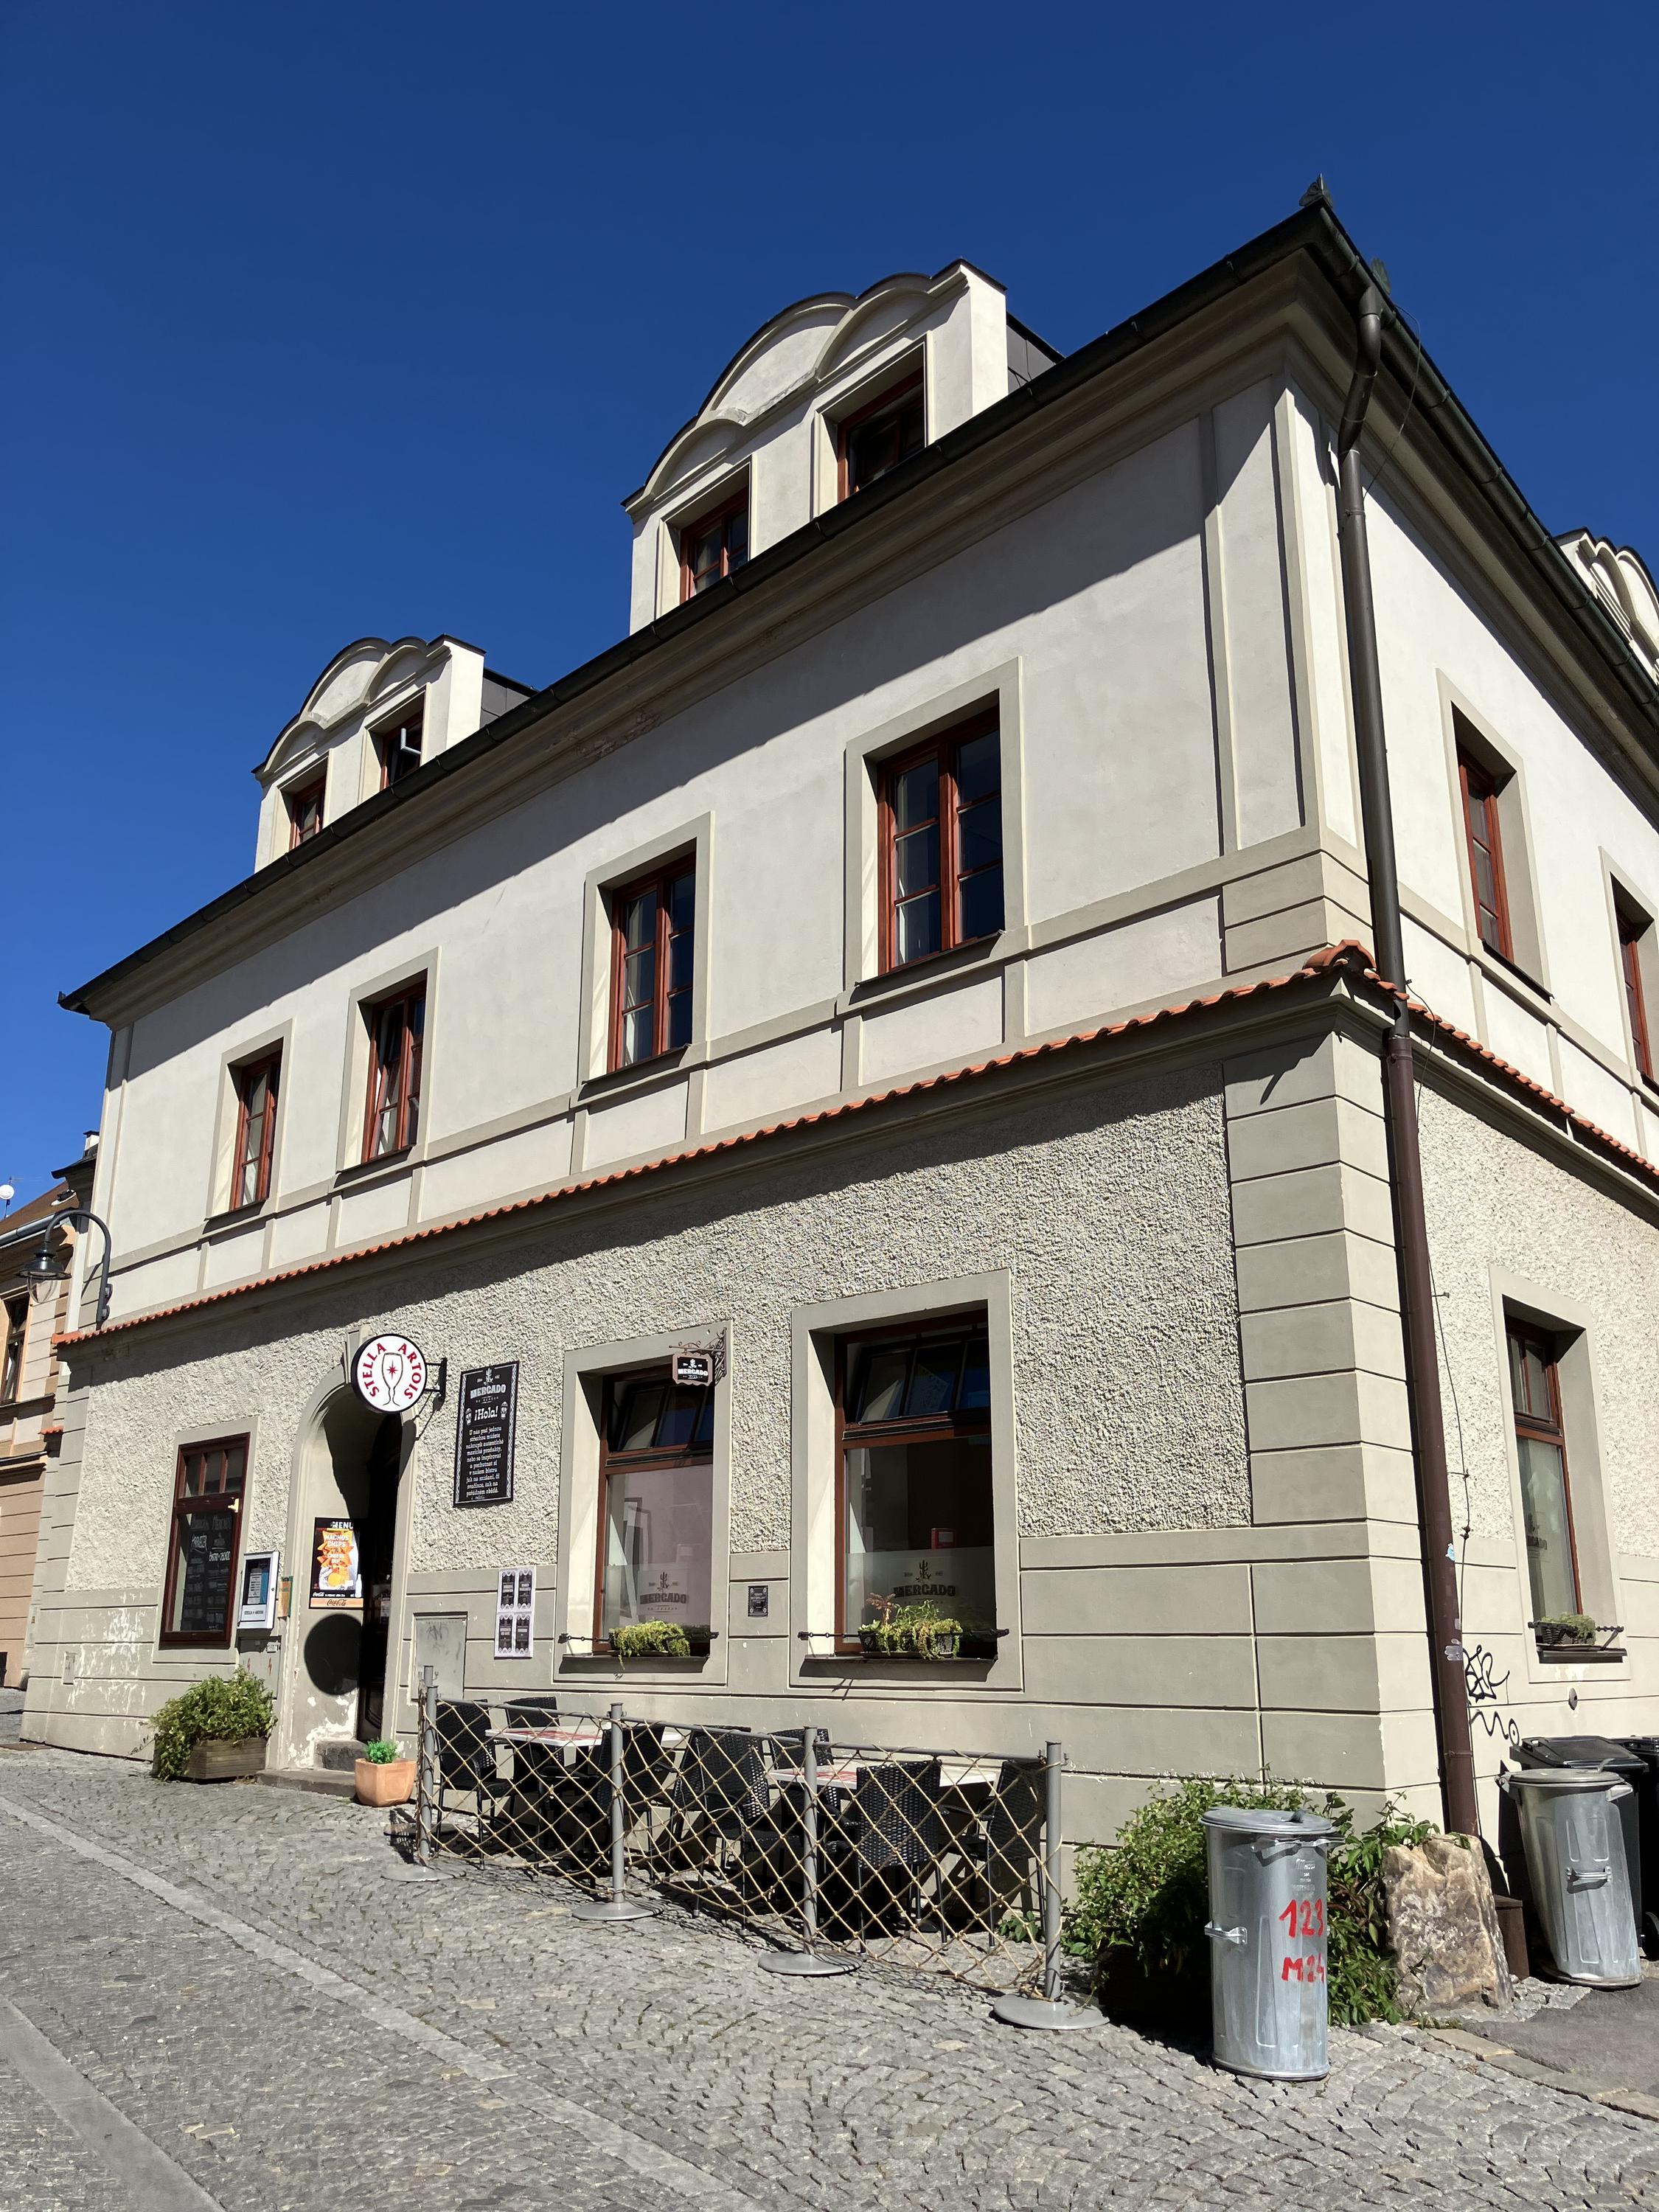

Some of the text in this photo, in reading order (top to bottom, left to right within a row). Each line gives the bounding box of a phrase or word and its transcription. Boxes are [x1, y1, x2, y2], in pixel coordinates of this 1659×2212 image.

[362, 1343, 422, 1399] STELLA ARTOIS
[470, 1384, 507, 1399] MERCADO
[474, 1405, 498, 1421] ¡Hola!
[640, 1593, 686, 1604] MERCADO
[893, 1584, 956, 1598] MERCADO
[1279, 1898, 1324, 1938] 123
